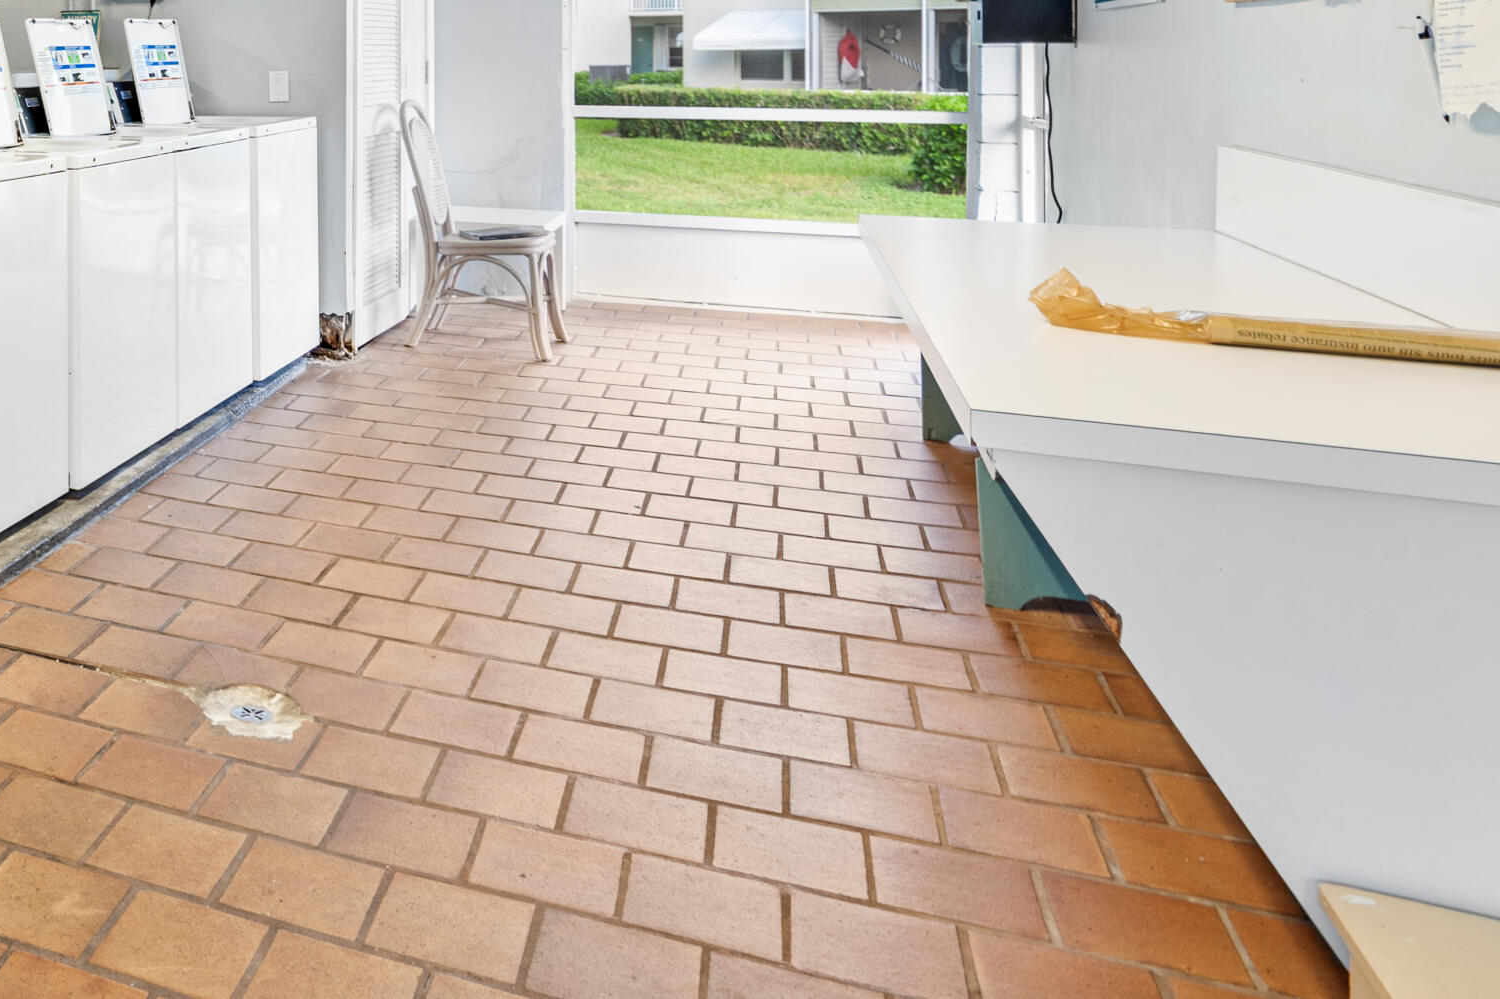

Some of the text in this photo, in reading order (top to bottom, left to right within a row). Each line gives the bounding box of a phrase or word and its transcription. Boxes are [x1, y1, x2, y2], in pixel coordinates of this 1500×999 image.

[1237, 329, 1287, 344] rebates
[1290, 335, 1359, 353] insurance
[1363, 343, 1396, 354] auto
[1426, 350, 1465, 361] touts
